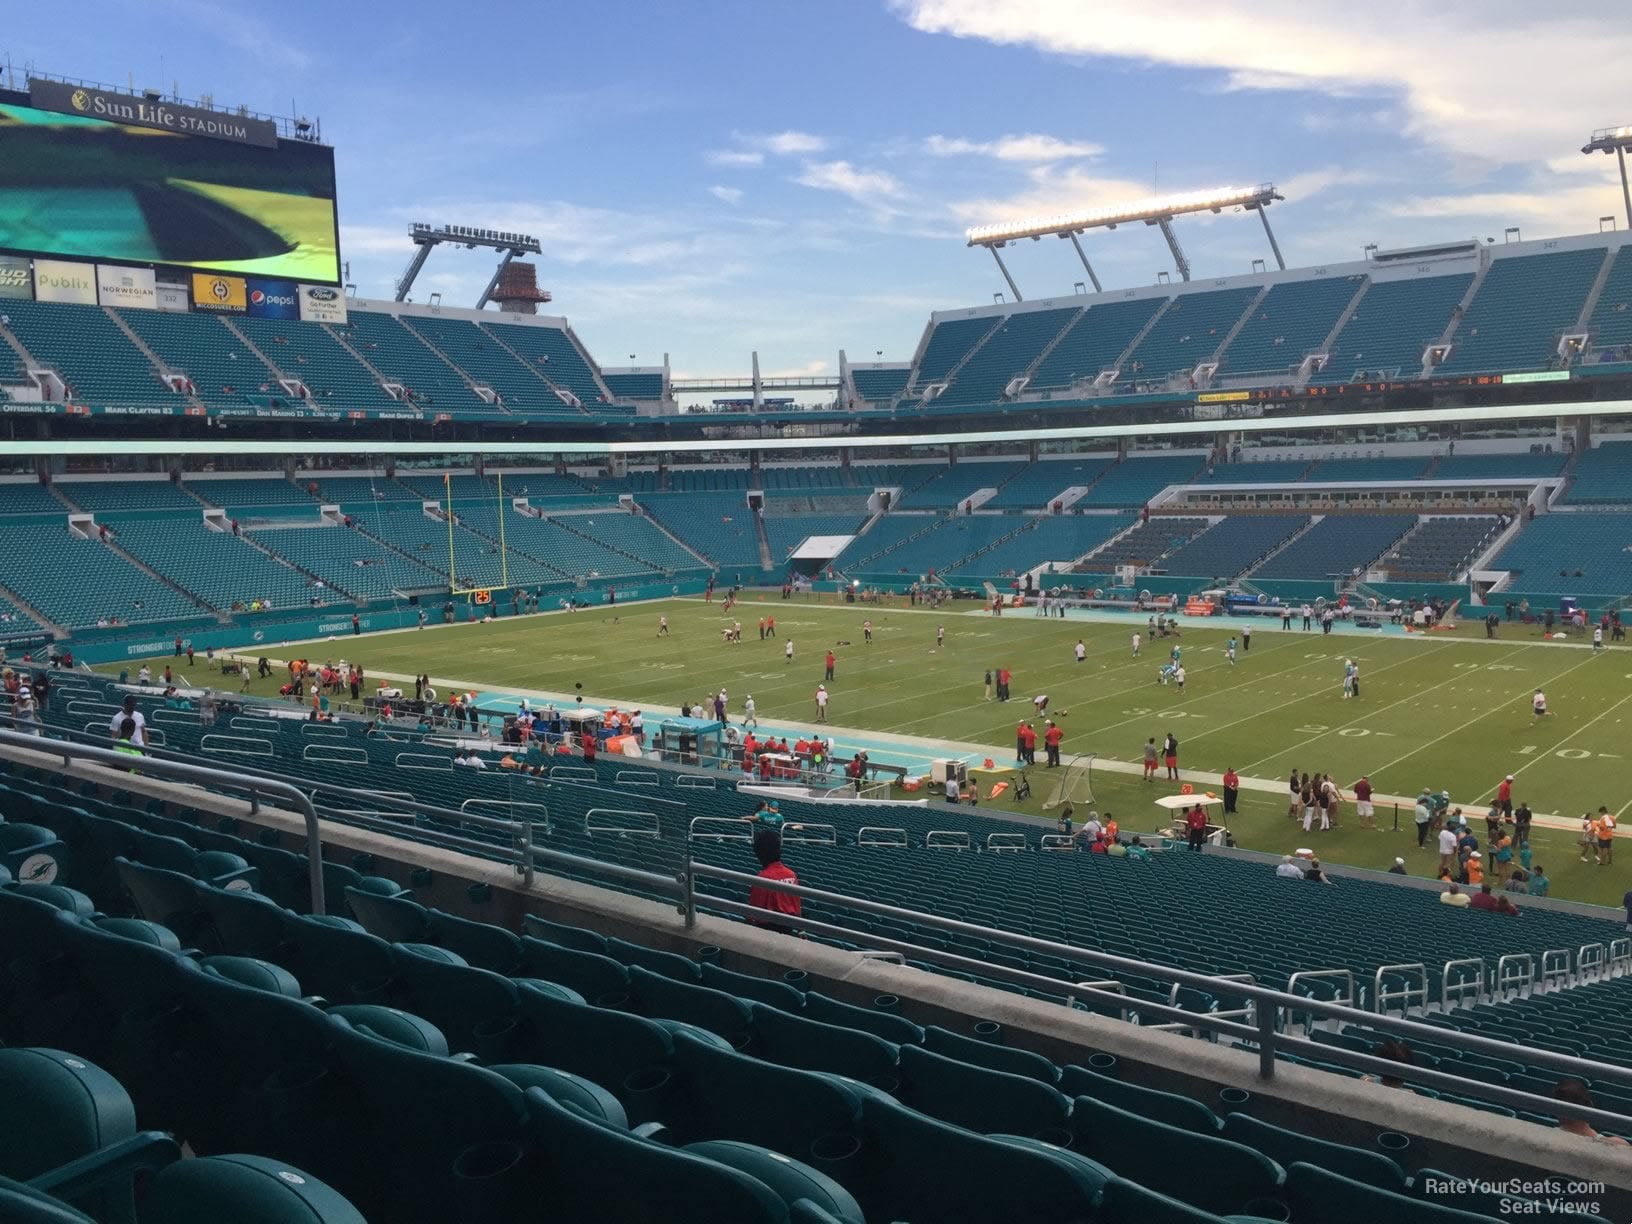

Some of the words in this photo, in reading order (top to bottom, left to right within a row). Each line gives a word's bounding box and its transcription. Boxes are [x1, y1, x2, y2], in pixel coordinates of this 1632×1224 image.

[94, 96, 133, 119] Sun
[138, 104, 174, 126] Life
[180, 116, 247, 139] STADIUM
[0, 269, 27, 278] UD
[0, 276, 31, 286] GHT
[39, 274, 89, 289] Publix
[103, 286, 153, 296] NORWEGIAN
[312, 288, 334, 300] Ford
[266, 295, 295, 307] pepsi
[477, 591, 489, 602] 25
